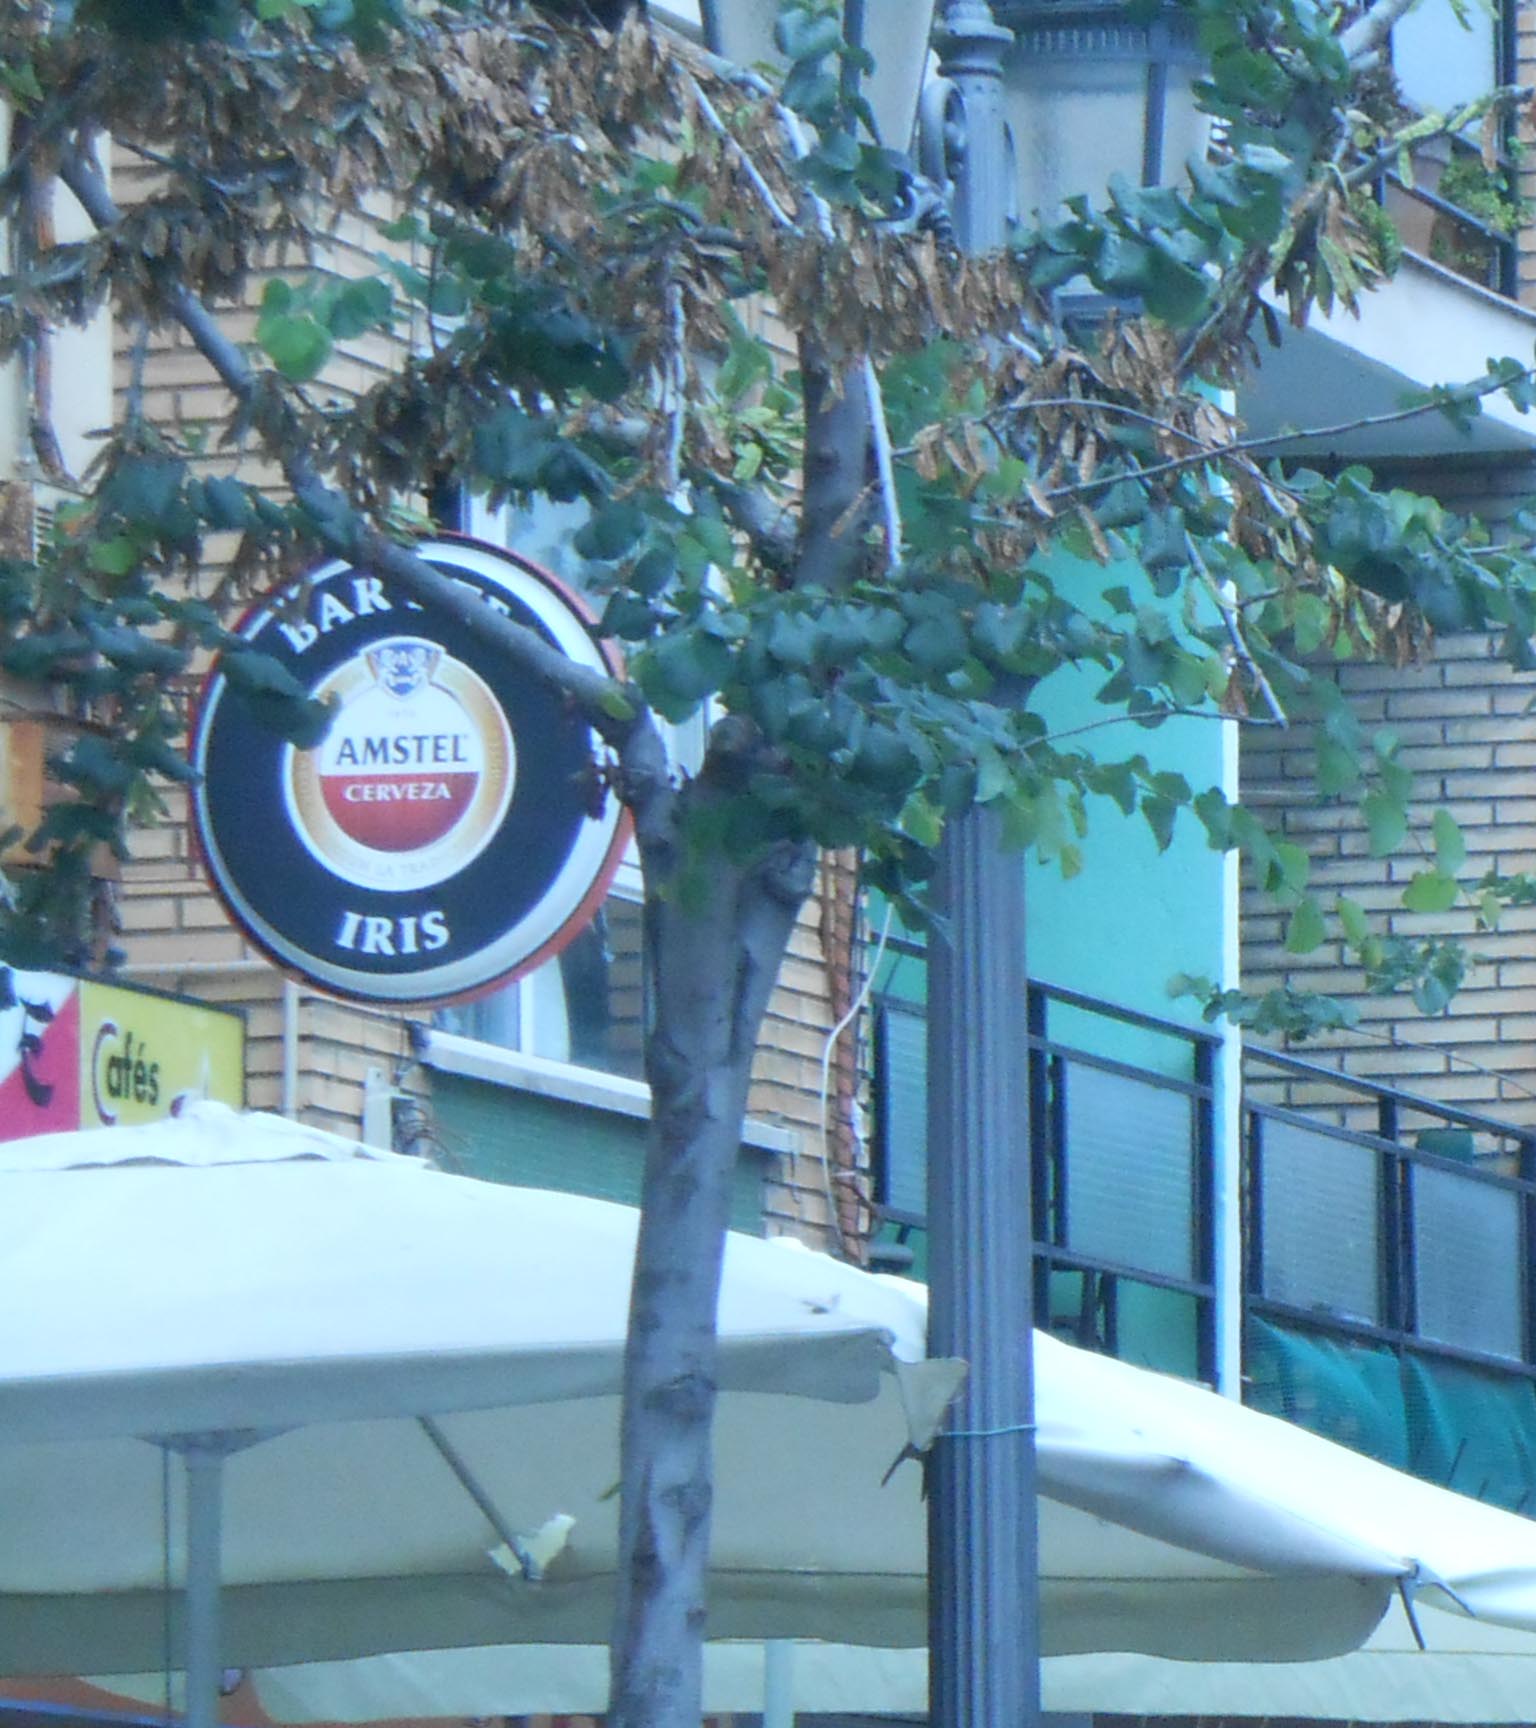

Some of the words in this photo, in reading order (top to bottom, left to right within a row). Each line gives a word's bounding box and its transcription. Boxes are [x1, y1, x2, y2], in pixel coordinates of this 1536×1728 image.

[279, 576, 393, 655] BAR
[336, 734, 468, 767] AMSTEL
[345, 781, 452, 802] CERVEZA
[336, 911, 449, 955] IRIS
[91, 1022, 160, 1128] Cafés
